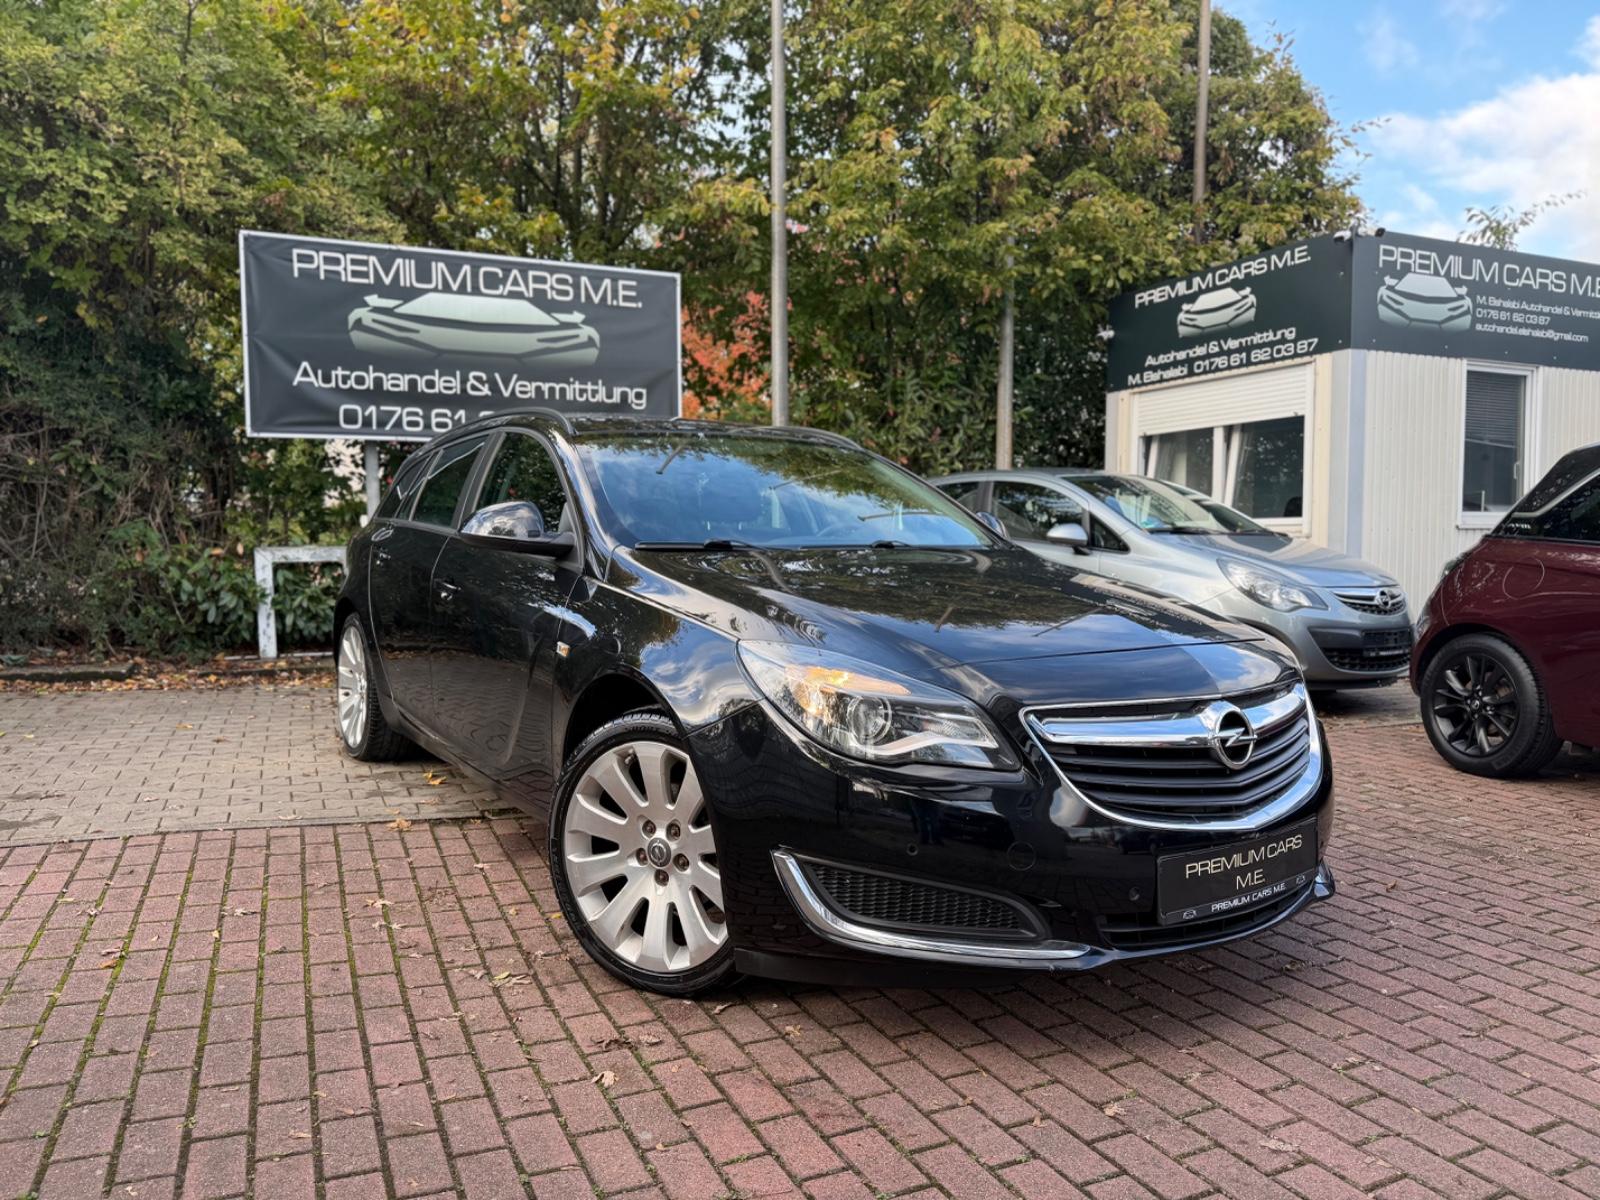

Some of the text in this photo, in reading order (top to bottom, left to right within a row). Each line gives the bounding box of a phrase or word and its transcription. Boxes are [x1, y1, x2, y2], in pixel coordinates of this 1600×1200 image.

[292, 248, 643, 308] PREMIUM CARS M.E.
[1135, 245, 1311, 308] PREMIUM CARS M.E.
[1379, 245, 1498, 284] PREMIUM
[1504, 264, 1566, 292] CARS
[1476, 308, 1550, 325] 0176 61 62 03 87
[1520, 301, 1562, 314] Autohandel
[1564, 306, 1570, 315] &
[1128, 373, 1142, 386] M.
[1194, 356, 1228, 373] 0176
[1230, 352, 1246, 366] 61
[1251, 348, 1271, 362] 62
[1273, 343, 1294, 358] 03
[1296, 338, 1318, 353] 87
[1144, 327, 1296, 368] Autohandel & Vermittlung
[292, 361, 647, 410] Autohandel & Vermittlung
[338, 404, 466, 432] 0176 61
[1186, 834, 1302, 878] PREMIUM CARS
[1211, 895, 1250, 912] PREMIUM
[1252, 888, 1272, 901] CARS
